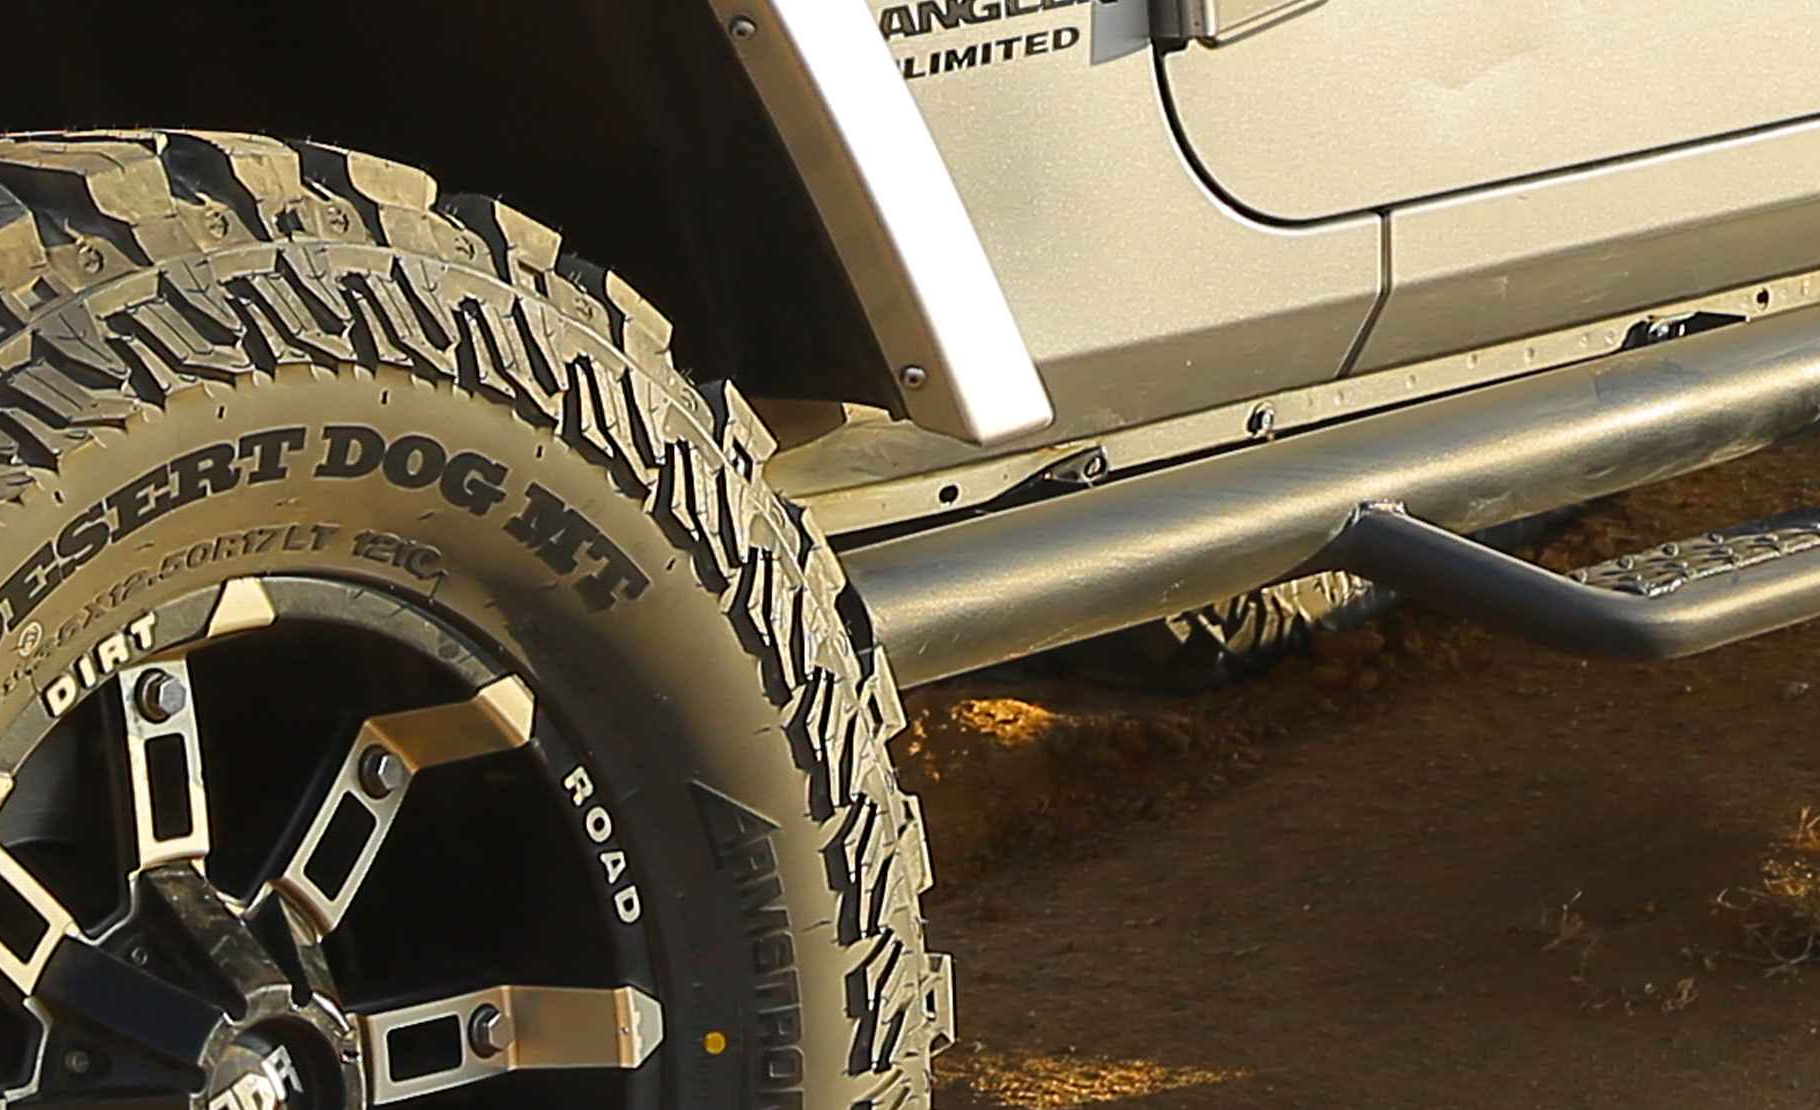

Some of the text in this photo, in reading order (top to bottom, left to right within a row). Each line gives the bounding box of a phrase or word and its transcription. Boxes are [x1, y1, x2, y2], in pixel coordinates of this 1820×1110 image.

[896, 26, 1080, 80] LIMITED
[313, 426, 509, 516] DOG
[504, 482, 651, 614] MT
[42, 611, 158, 718] DIRT
[563, 765, 643, 924] ROAD
